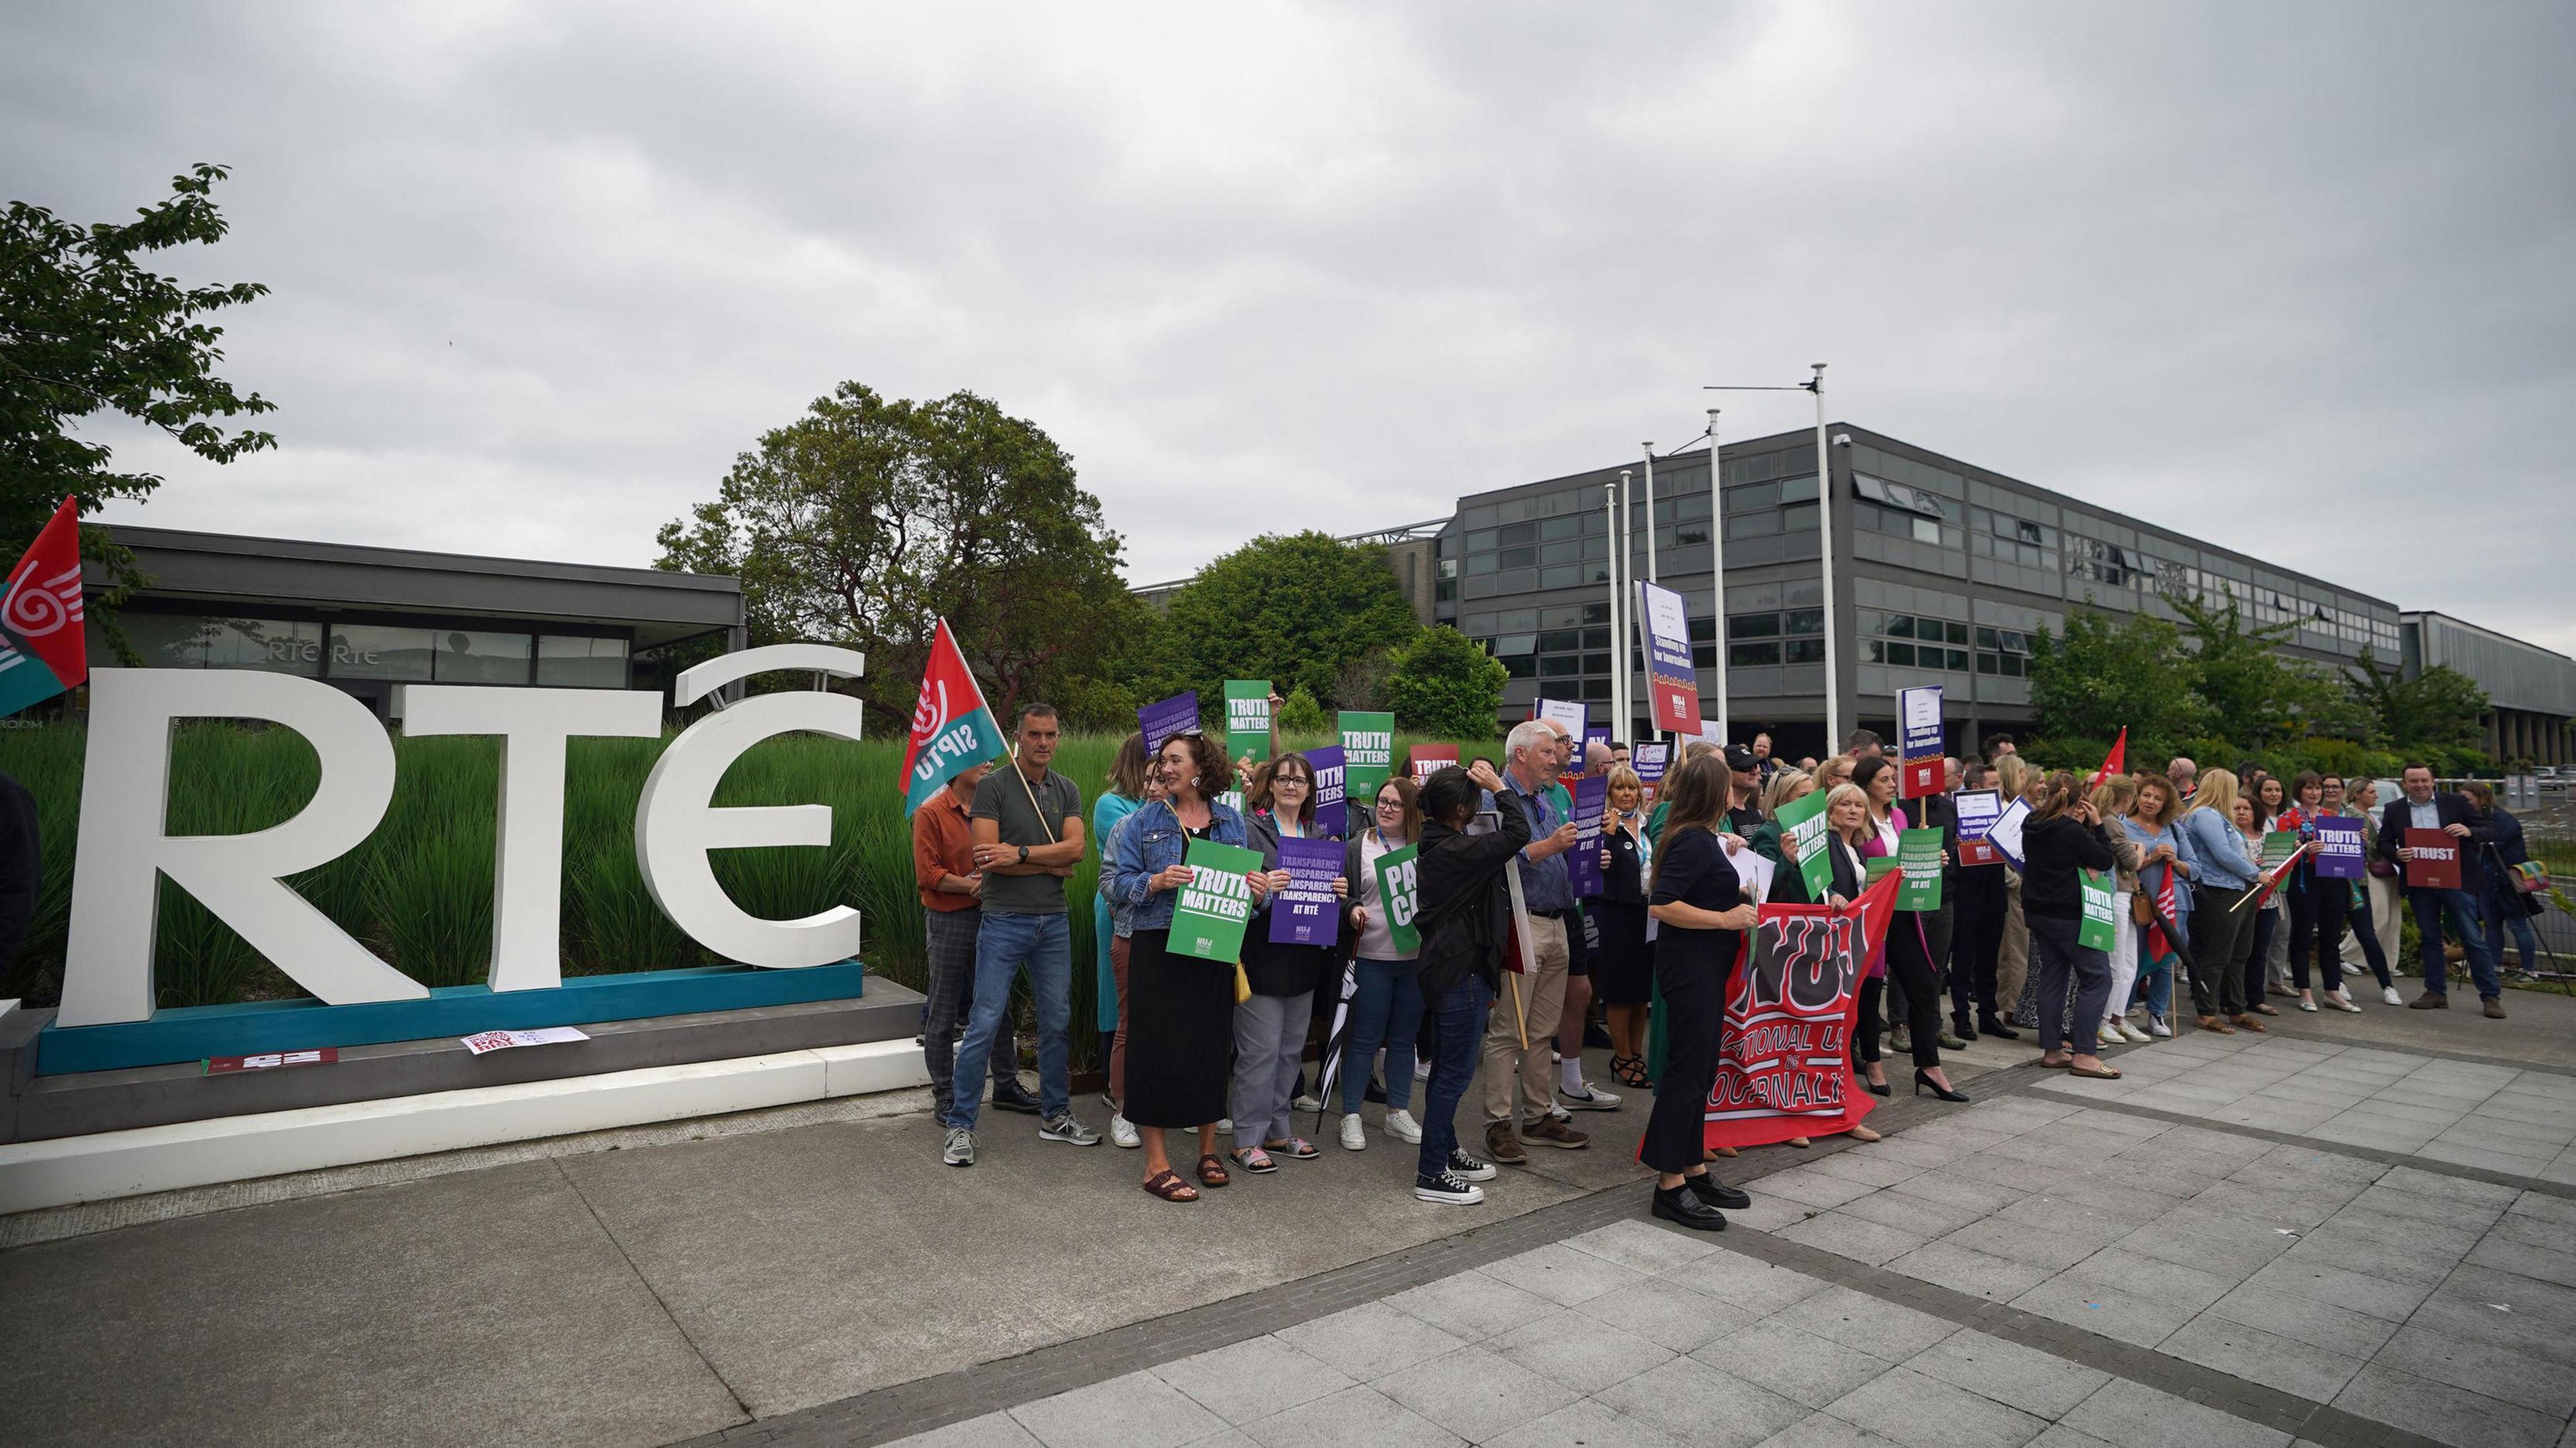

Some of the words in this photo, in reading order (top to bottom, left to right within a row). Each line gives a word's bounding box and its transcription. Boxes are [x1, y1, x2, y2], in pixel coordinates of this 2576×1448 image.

[268, 639, 319, 662] RTÉ
[1655, 635, 1679, 652] Standing
[1678, 643, 1686, 655] up
[1654, 649, 1662, 661] for
[1663, 651, 1690, 669] Journalism
[1229, 699, 1269, 716] TRUTH
[1672, 694, 1685, 706] NUJ
[1145, 708, 1195, 732] TRANSPARENCY
[1230, 717, 1269, 730] MATTERS
[1147, 716, 1196, 740] TRANSPARENCY
[1909, 727, 1931, 737] Standing
[1931, 726, 1937, 734] up
[1342, 731, 1391, 750] TRUTH
[1914, 736, 1941, 747] Journalism
[1315, 766, 1343, 788] UTH
[1919, 768, 1931, 776] NUJ
[1316, 787, 1343, 803] TTERS
[1789, 810, 1826, 845] TRUTH
[1962, 818, 1988, 826] Standing
[60, 644, 865, 1027] RTÉ
[2318, 830, 2361, 844] TRUTH
[1283, 844, 1341, 858] TRANSPARENCY
[1580, 841, 1586, 851] AT
[1586, 838, 1595, 850] RTÉ
[2412, 846, 2455, 860] TRUST
[1282, 856, 1341, 870] TRANSPARENCY
[1188, 864, 1251, 900] TRUTH
[1385, 858, 1417, 897] PA
[1911, 881, 1919, 889] AT
[1919, 880, 1930, 889] RTÉ
[1287, 880, 1333, 892] ANSPARENC
[1181, 889, 1248, 918] MATTERS
[1279, 890, 1336, 903] TRANSPARENCY
[2083, 885, 2112, 909] TRUTH
[1293, 904, 1303, 915] AT
[1304, 903, 1319, 915] RTÉ
[2084, 902, 2113, 922] MATTERS
[1197, 937, 1213, 946] NUJ
[1728, 903, 1871, 1016] NUJ
[1785, 1055, 1800, 1070] OF
